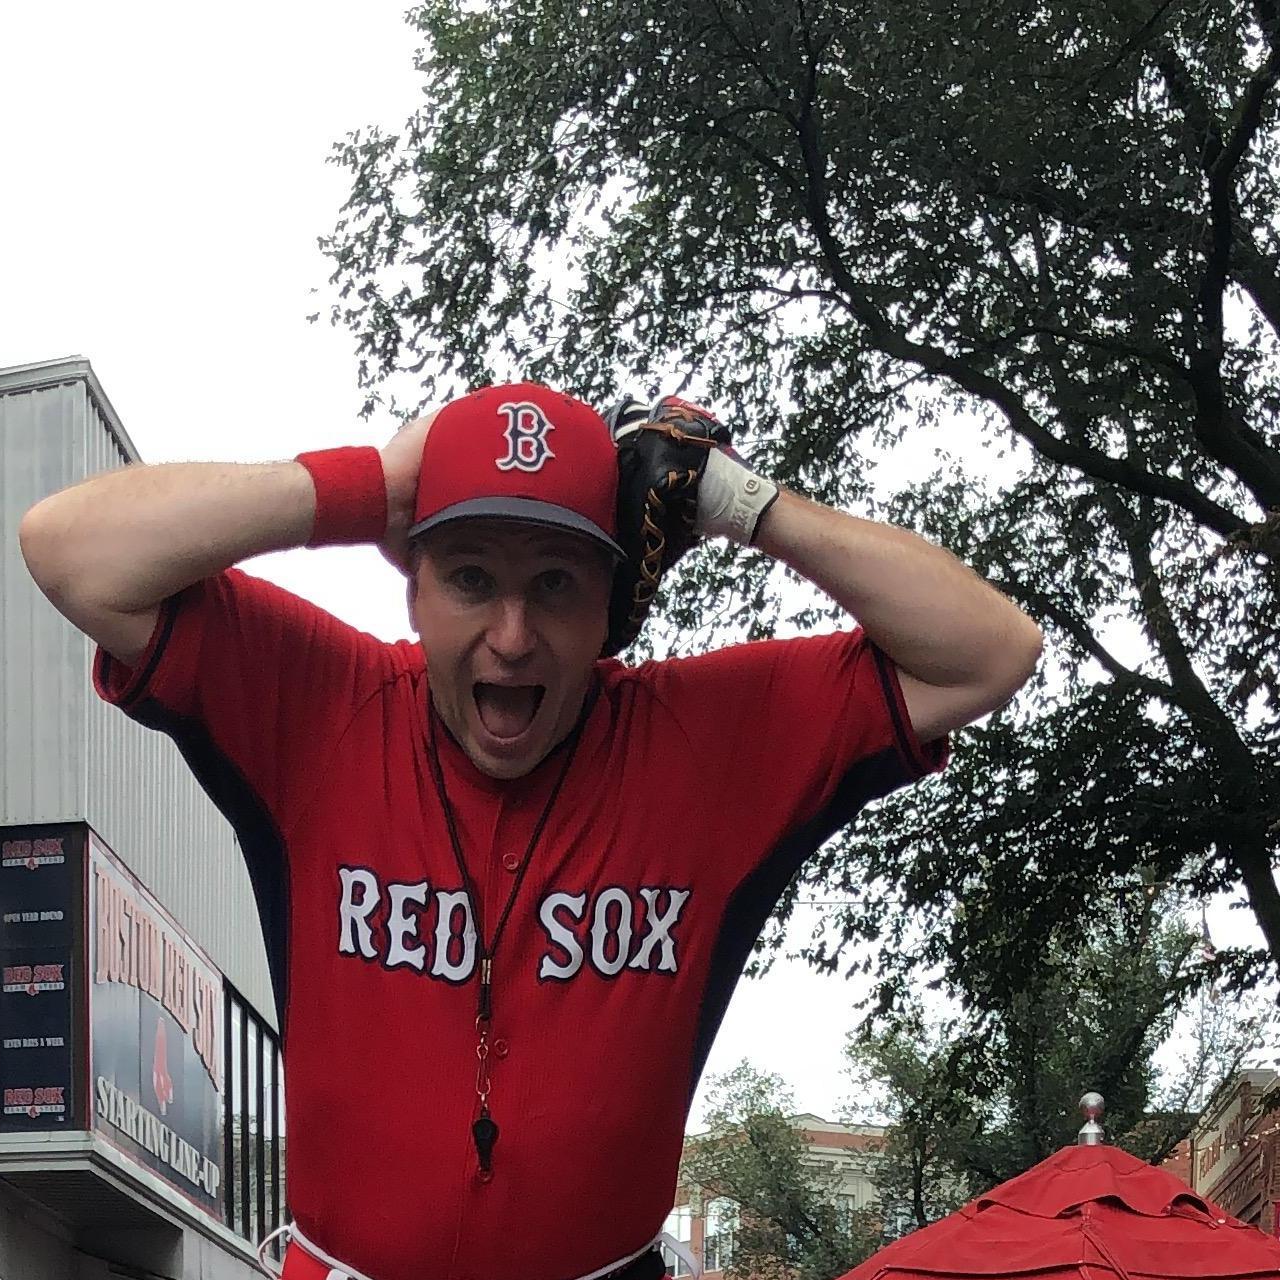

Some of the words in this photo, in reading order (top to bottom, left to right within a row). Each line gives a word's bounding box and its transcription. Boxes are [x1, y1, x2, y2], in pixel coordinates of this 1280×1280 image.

[494, 401, 556, 473] B
[337, 866, 479, 983] RED
[538, 886, 692, 981] SOX
[3, 966, 32, 983] RED
[33, 964, 64, 982] SOX
[94, 865, 161, 1002] BOSTON
[161, 930, 190, 1035] RED
[193, 966, 220, 1093] SOX
[4, 1088, 33, 1106] RED
[34, 1086, 65, 1104] SOX
[96, 1076, 174, 1166] STARTING
[174, 1143, 220, 1199] LINE-UP
